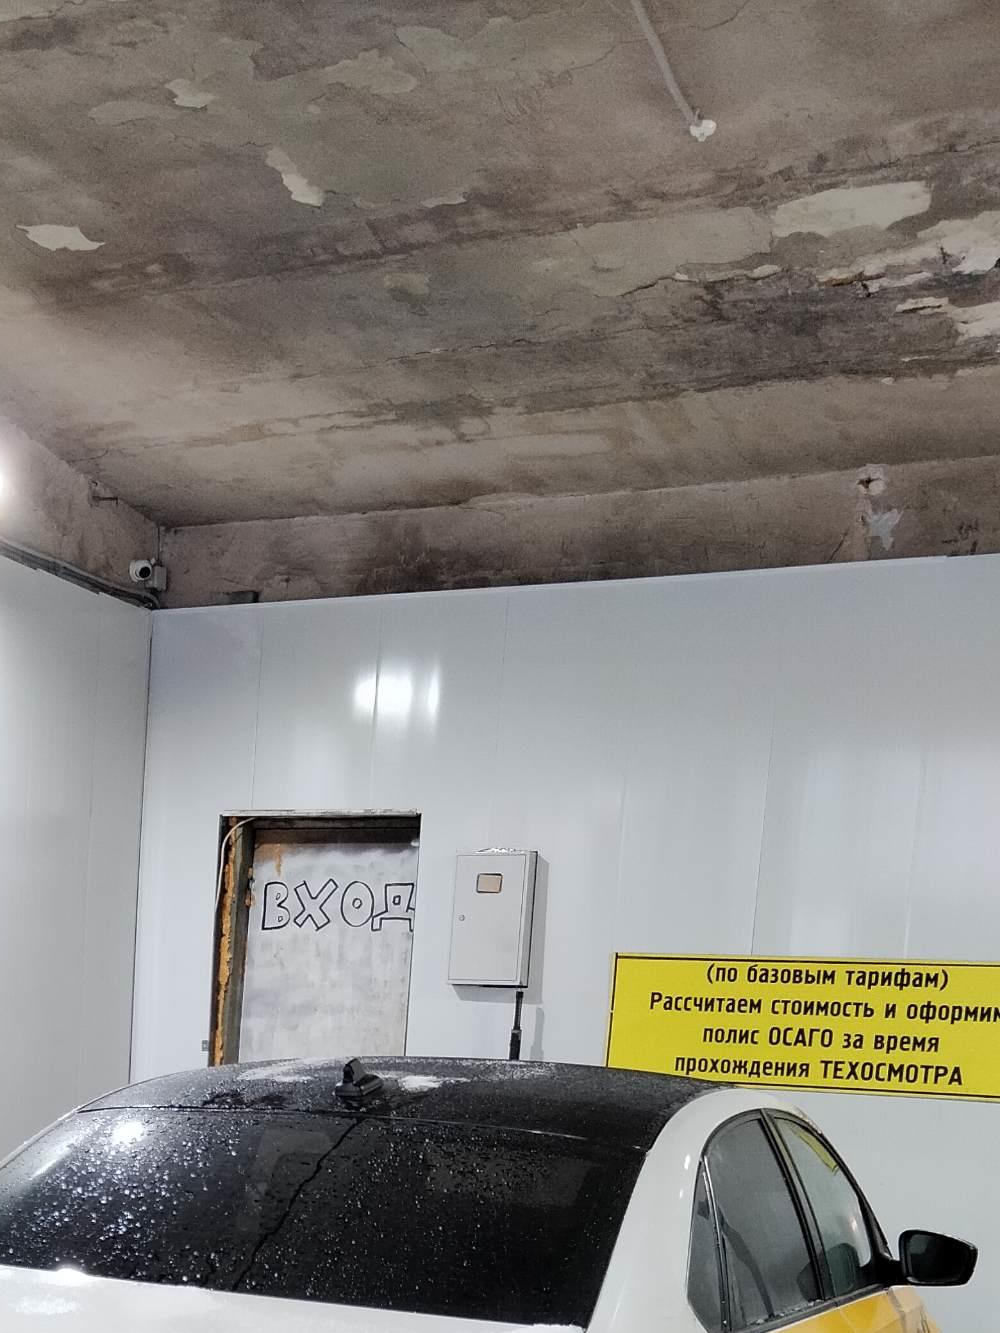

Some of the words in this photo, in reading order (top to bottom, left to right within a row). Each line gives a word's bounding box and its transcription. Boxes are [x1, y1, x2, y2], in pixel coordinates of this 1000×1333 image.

[261, 878, 416, 932] ВХОД
[706, 963, 738, 984] (по
[746, 964, 836, 986] базовым
[844, 967, 949, 991] тарифам)
[650, 992, 762, 1015] Рассчитаем
[771, 998, 875, 1019] стоимость
[884, 1003, 897, 1019] и
[702, 1026, 760, 1046] полис
[768, 1026, 834, 1049] ОСАГО
[842, 1032, 864, 1050] за
[873, 1034, 940, 1053] время
[674, 1056, 810, 1079] прохождения
[820, 1060, 963, 1086] ТЕХОСМОТРА
